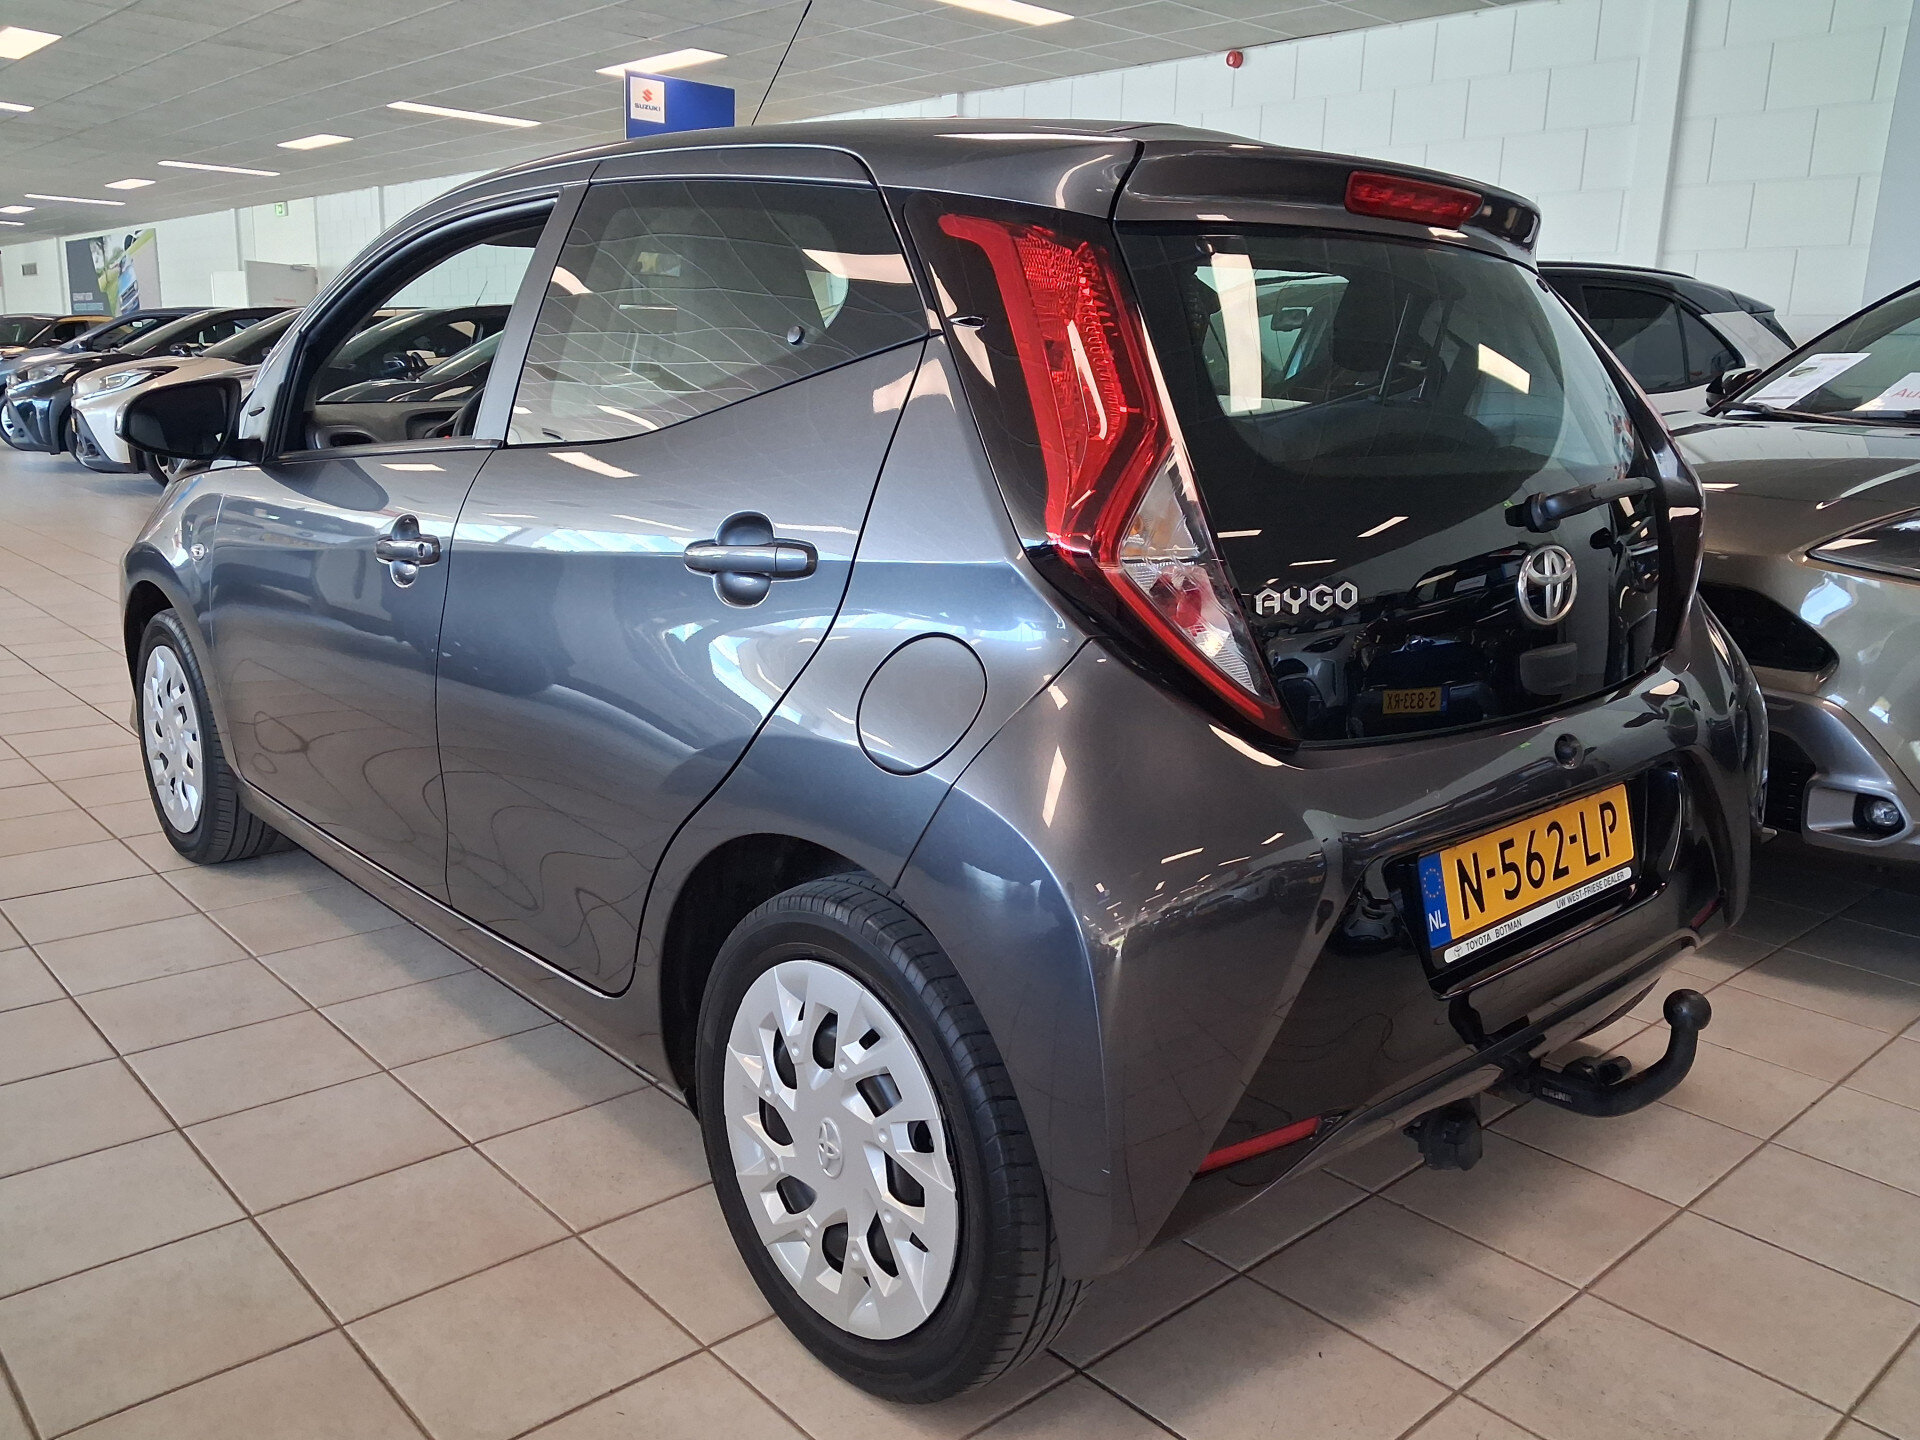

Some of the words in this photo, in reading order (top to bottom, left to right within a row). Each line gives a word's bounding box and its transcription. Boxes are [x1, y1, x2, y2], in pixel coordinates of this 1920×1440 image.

[634, 102, 661, 112] SUZUKI
[1890, 388, 1920, 398] Au
[1254, 581, 1358, 615] AYGO
[1455, 801, 1618, 921] N-562-LP
[1428, 910, 1446, 932] NL
[1466, 933, 1492, 952] TOYOTA
[1494, 918, 1523, 938] BOTMAN
[1556, 899, 1566, 909] UW
[1567, 881, 1603, 903] WEST-FRIESE
[1603, 871, 1625, 888] DEALER
